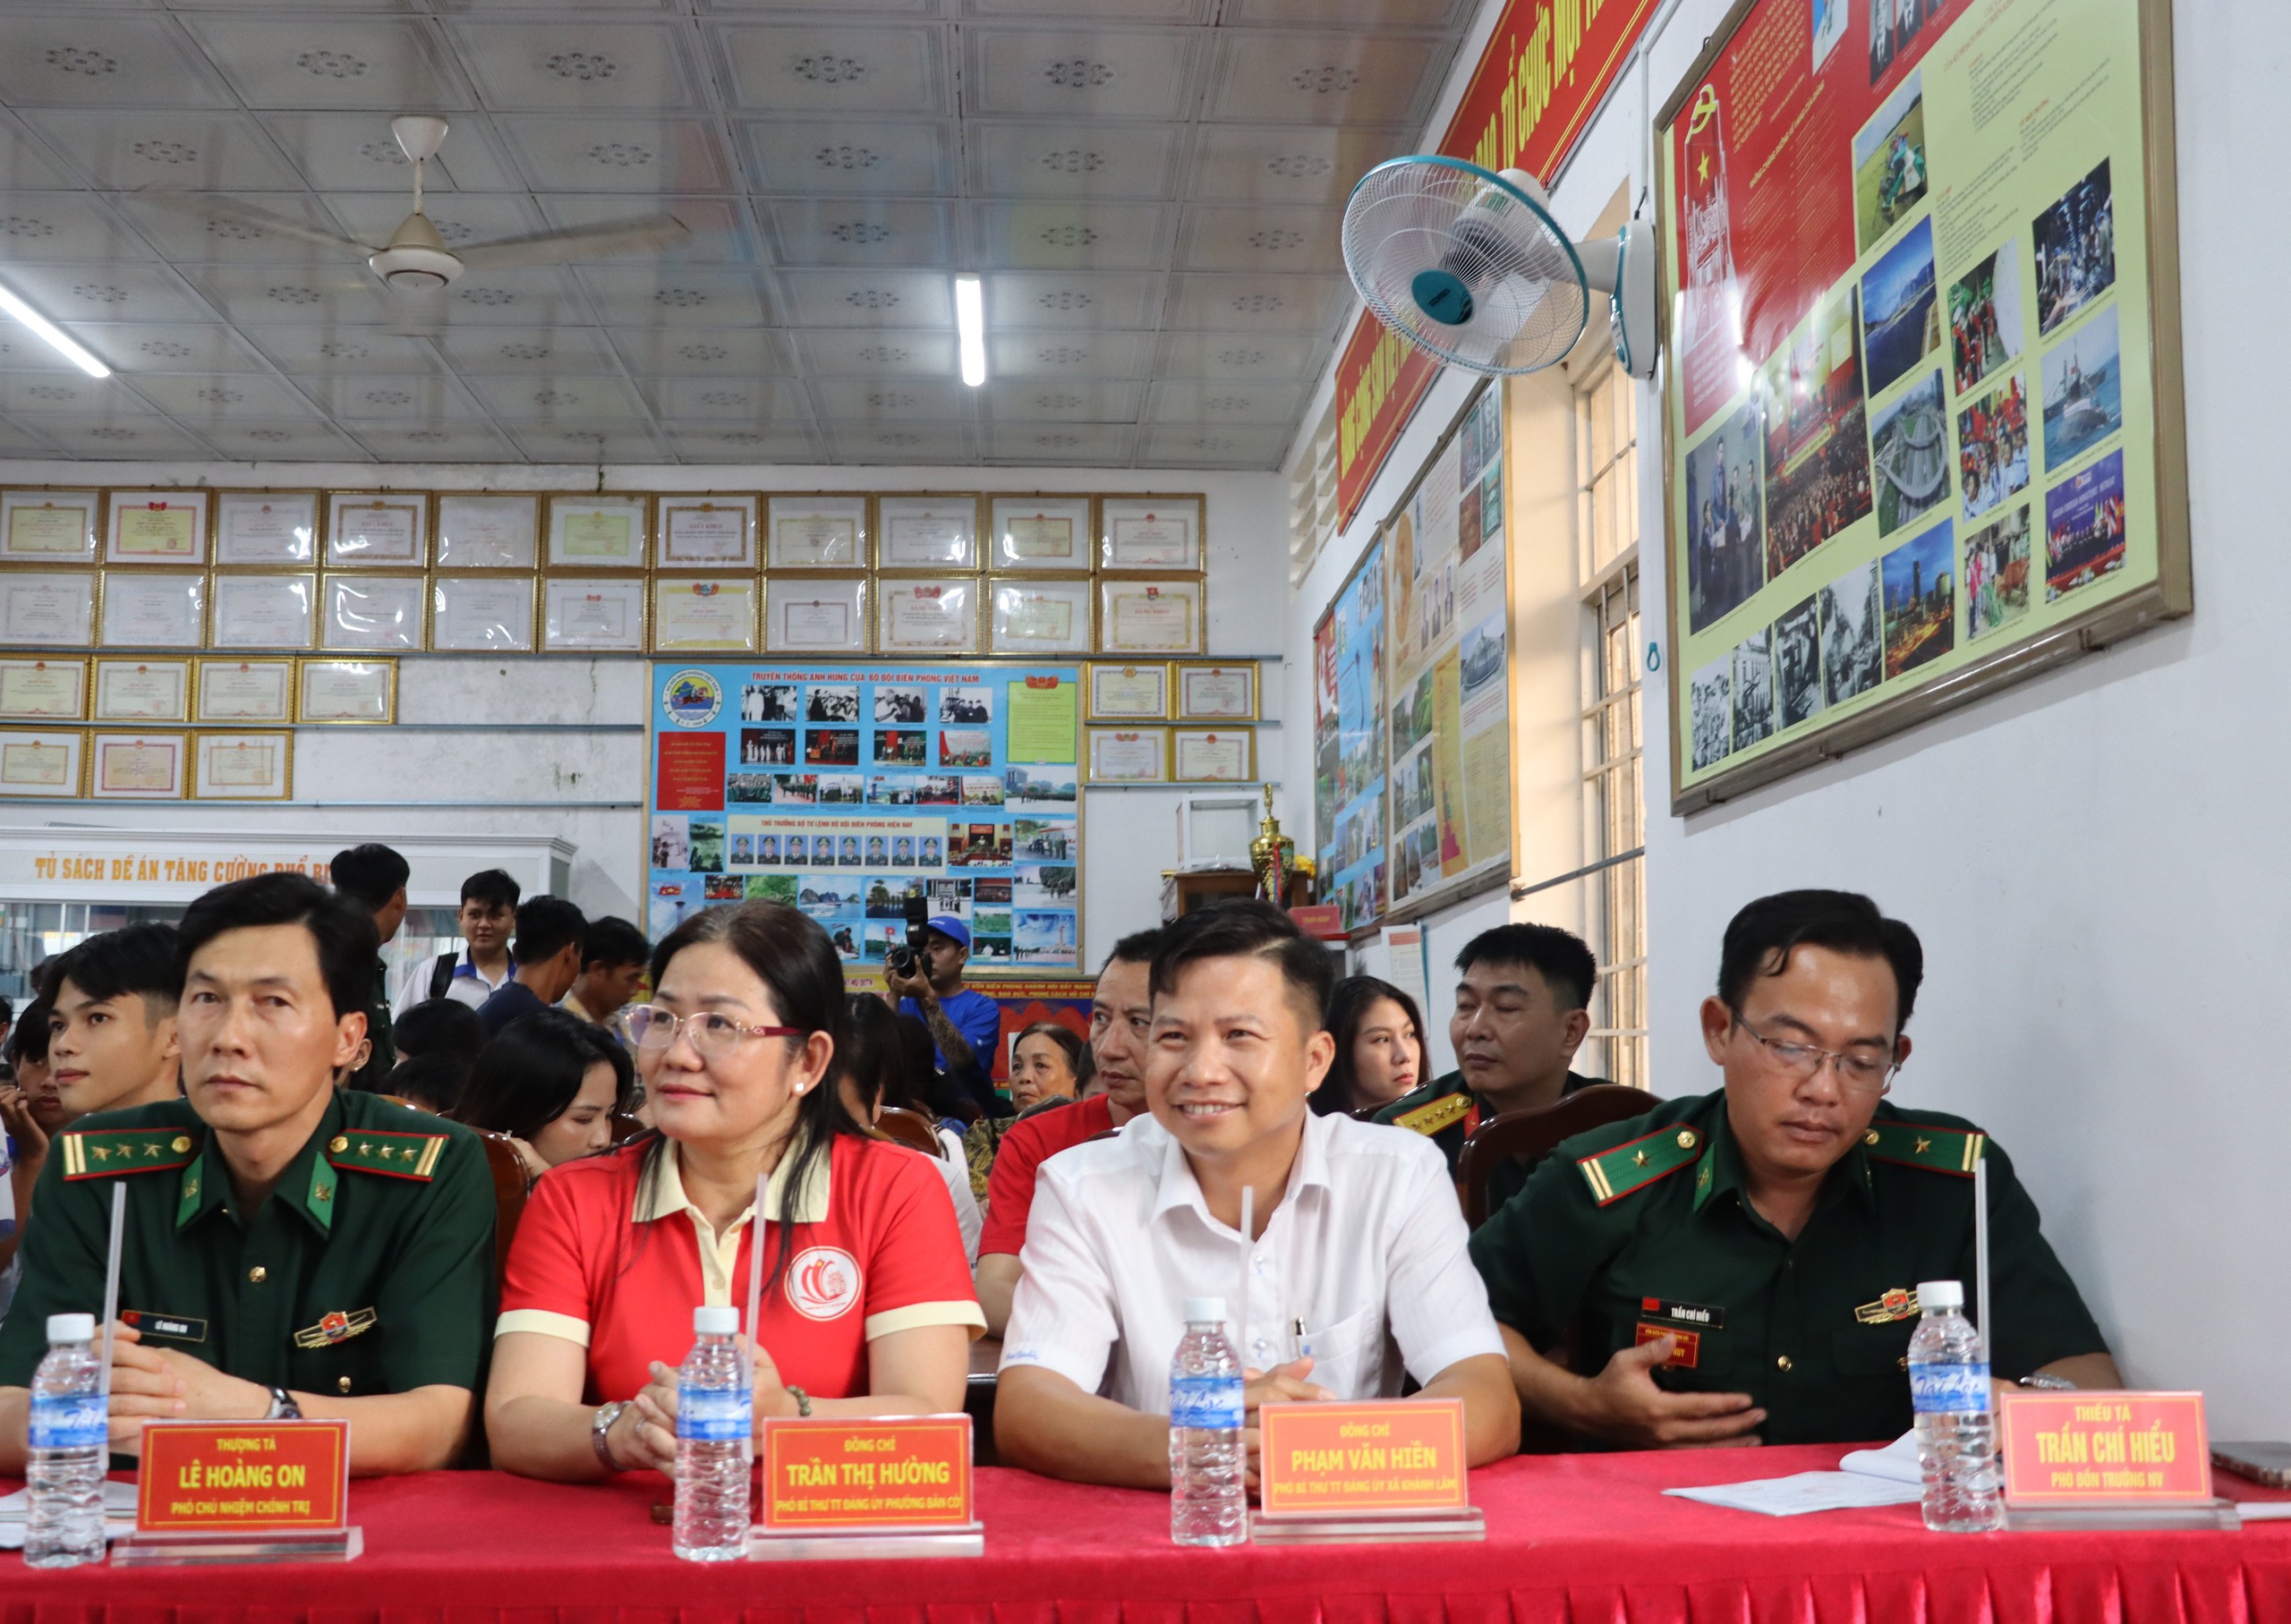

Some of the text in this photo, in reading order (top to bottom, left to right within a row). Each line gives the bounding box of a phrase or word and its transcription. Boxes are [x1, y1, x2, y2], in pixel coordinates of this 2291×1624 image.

[1518, 1, 1551, 152] CHỨC
[810, 673, 825, 681] ANH
[961, 675, 979, 683] NAM
[35, 850, 56, 880] TỦ
[62, 849, 105, 880] SÁCH
[111, 853, 134, 880] ĐỀ
[137, 850, 159, 881] ÁN
[165, 856, 208, 882] TĂNG
[2115, 1402, 2131, 1422] TÁ
[876, 1435, 897, 1451] CHÍ
[1371, 1420, 1390, 1437] CHÍ
[2092, 1426, 2126, 1463] CHÍ
[179, 1458, 306, 1489] LÊ HOÀNG ON
[786, 1455, 950, 1491] TRẦN THỊ HƯỜNG
[1291, 1440, 1437, 1476] PHẠM VĂN HIỀN
